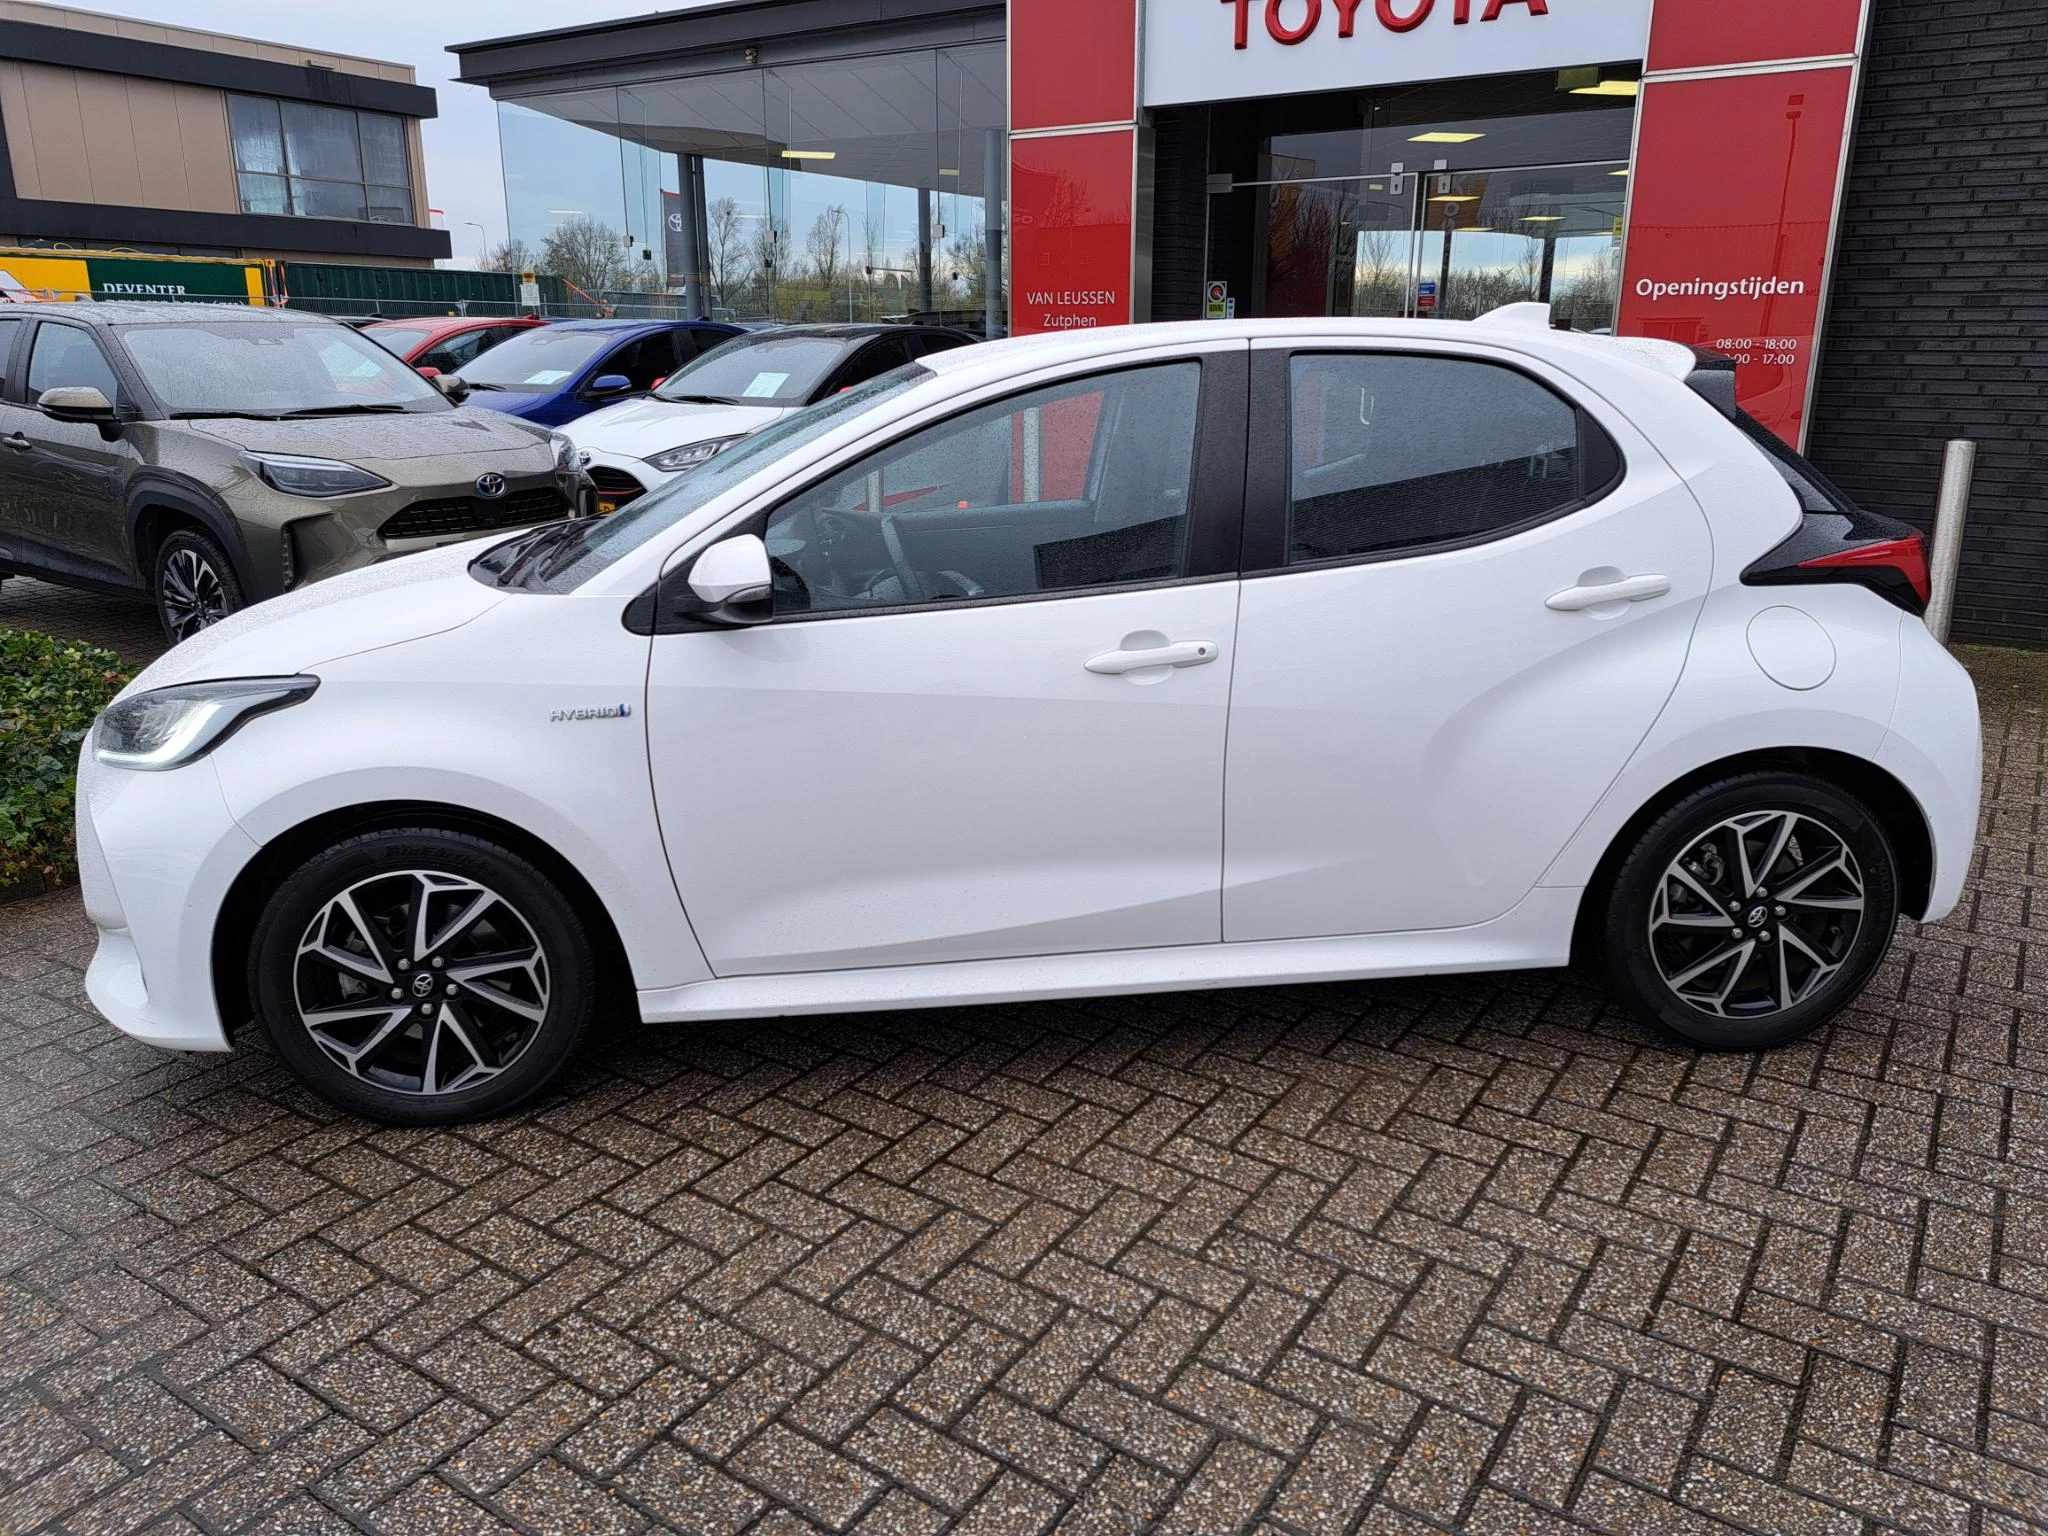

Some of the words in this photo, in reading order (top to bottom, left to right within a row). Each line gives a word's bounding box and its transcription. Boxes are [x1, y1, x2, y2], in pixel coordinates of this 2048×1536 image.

[102, 283, 187, 295] DEVENTER
[1636, 276, 1804, 300] Openingstijden
[1026, 291, 1053, 305] VAN
[1057, 290, 1116, 305] LEUSSEN
[1043, 313, 1097, 329] Zutphen
[1716, 338, 1752, 350] 08:00
[1763, 338, 1797, 350] 18:00
[1762, 353, 1795, 365] 17:00
[550, 707, 619, 722] HYBRID
